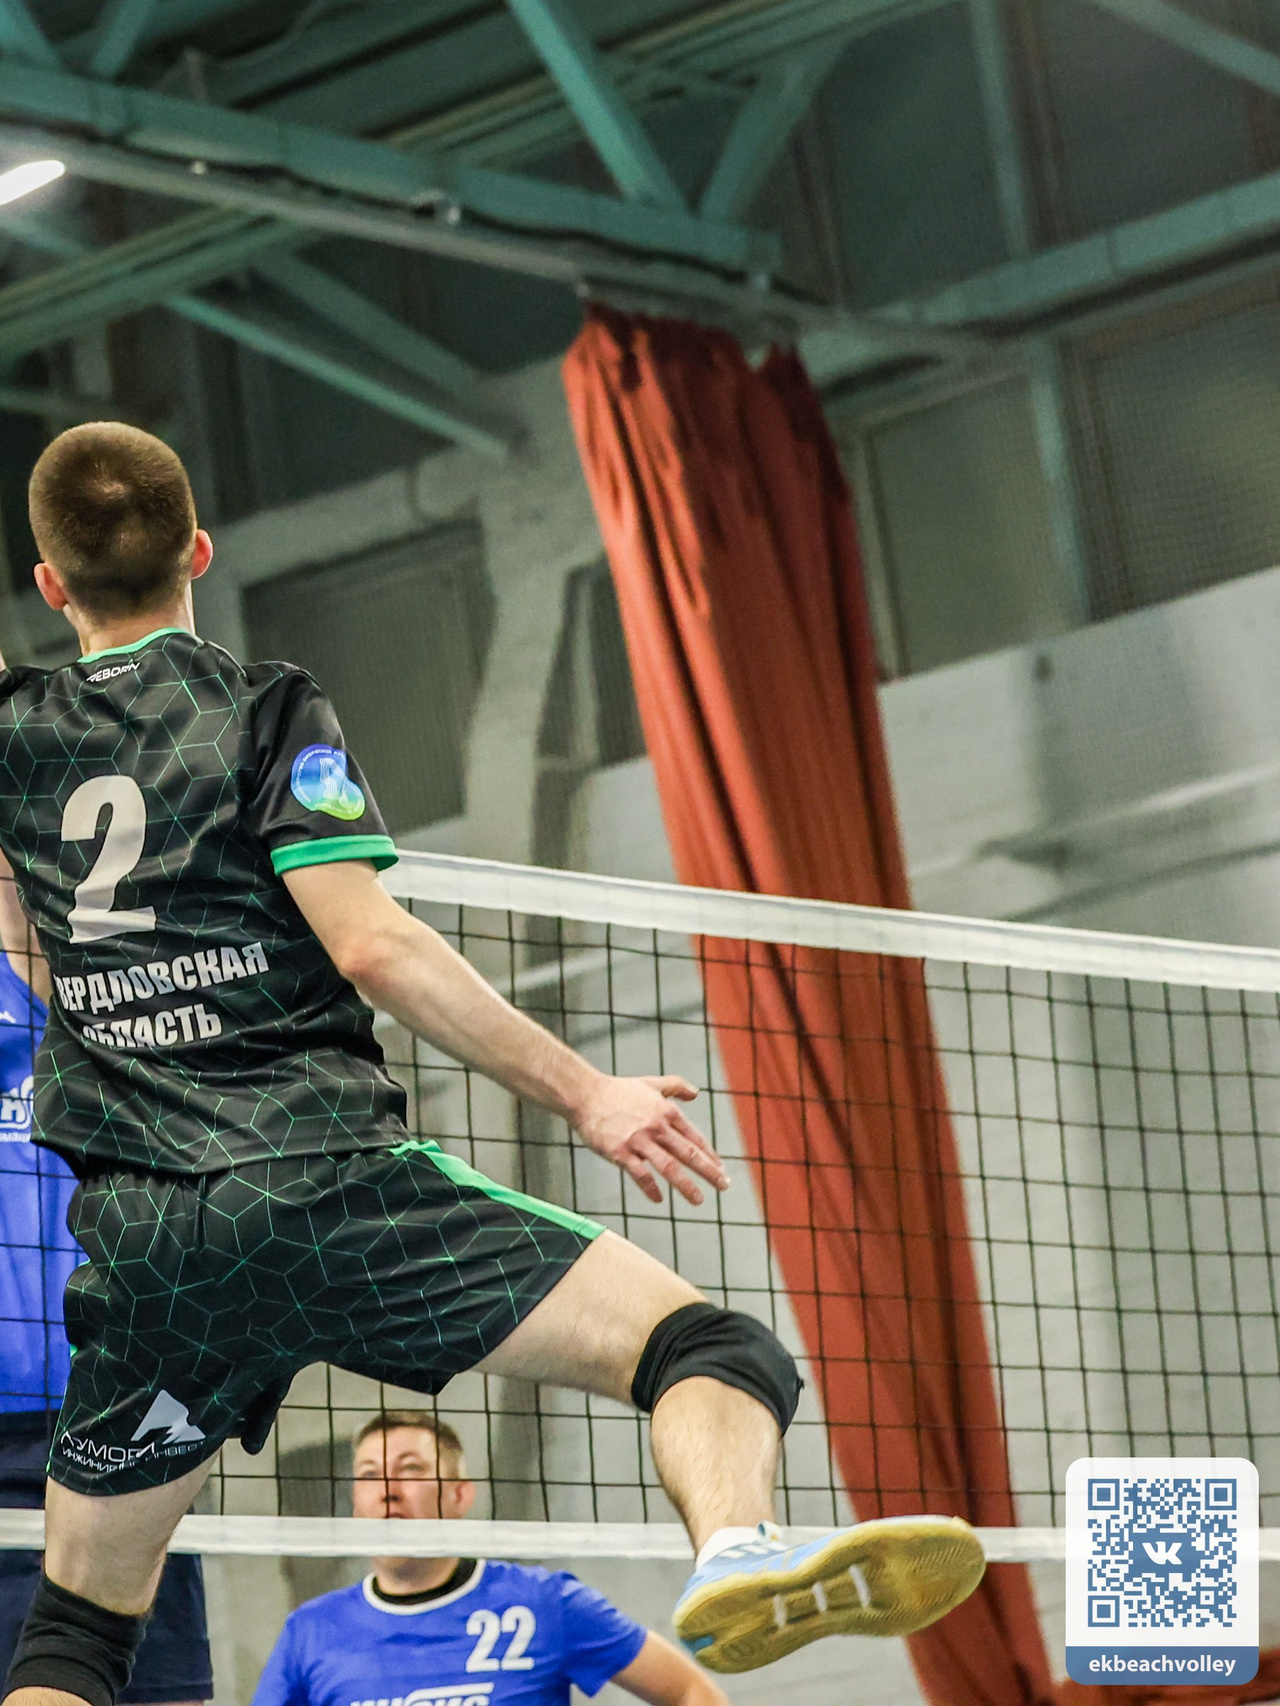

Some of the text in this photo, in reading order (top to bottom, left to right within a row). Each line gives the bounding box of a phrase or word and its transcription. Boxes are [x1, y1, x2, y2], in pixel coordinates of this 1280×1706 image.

[86, 662, 141, 683] REBORN
[61, 774, 157, 944] 2
[52, 942, 269, 1016] ВЕРДЛОВСКАЯ
[465, 1605, 536, 1673] 22
